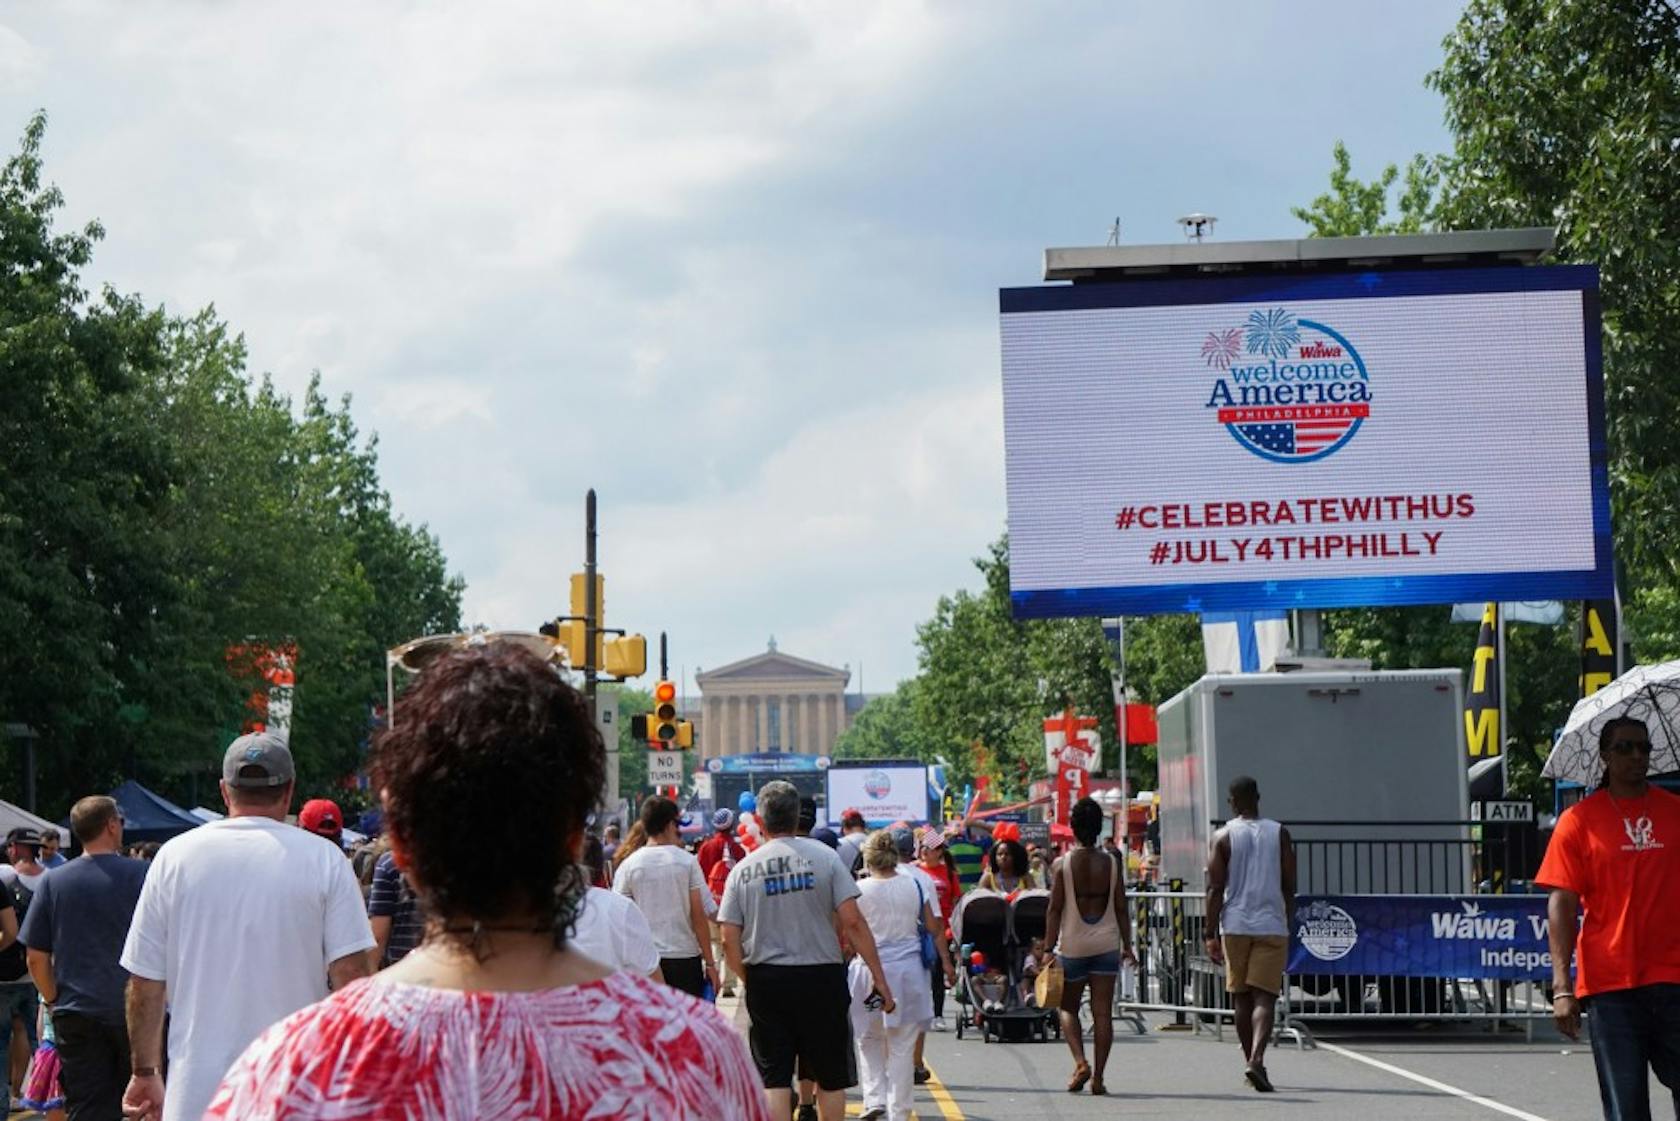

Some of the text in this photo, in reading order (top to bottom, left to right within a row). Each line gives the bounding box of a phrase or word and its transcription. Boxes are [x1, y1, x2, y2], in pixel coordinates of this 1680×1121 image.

[1300, 344, 1342, 359] Wawa
[1231, 360, 1355, 383] welcome
[1205, 379, 1373, 407] America
[1236, 408, 1351, 420] PHILADELPHIA
[1115, 493, 1475, 530] #CELEBRATEWITHUS
[1149, 531, 1443, 565] #JULY4THPHILLY
[658, 756, 674, 767] NO
[651, 771, 681, 781] TURNS
[1491, 804, 1528, 819] ATM
[740, 855, 813, 884] BACK the
[764, 871, 815, 897] BLUE
[1297, 925, 1358, 938] America
[1432, 912, 1515, 940] Wawa
